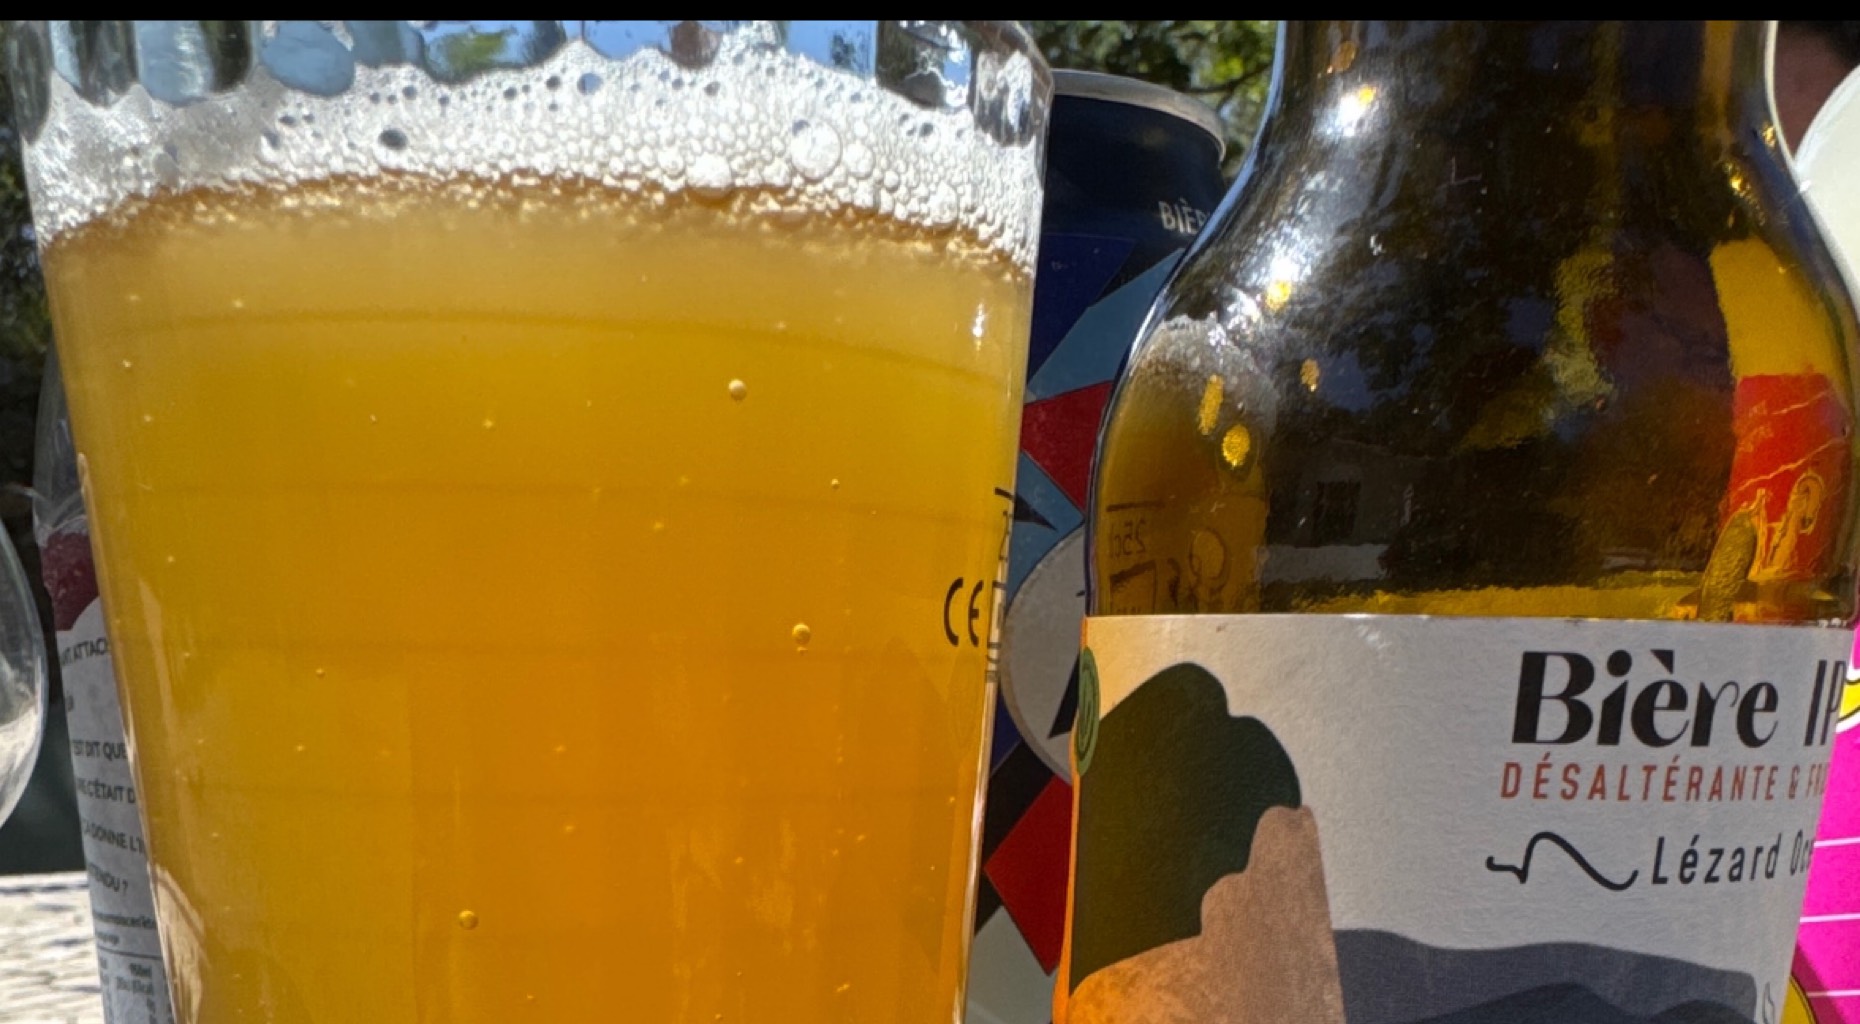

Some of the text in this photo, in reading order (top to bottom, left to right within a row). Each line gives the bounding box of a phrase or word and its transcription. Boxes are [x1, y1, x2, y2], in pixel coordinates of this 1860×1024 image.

[1511, 648, 1779, 748] Bière
[1500, 752, 1778, 803] DÉSALTÉRANTE
[1651, 831, 1782, 885] Lézard
